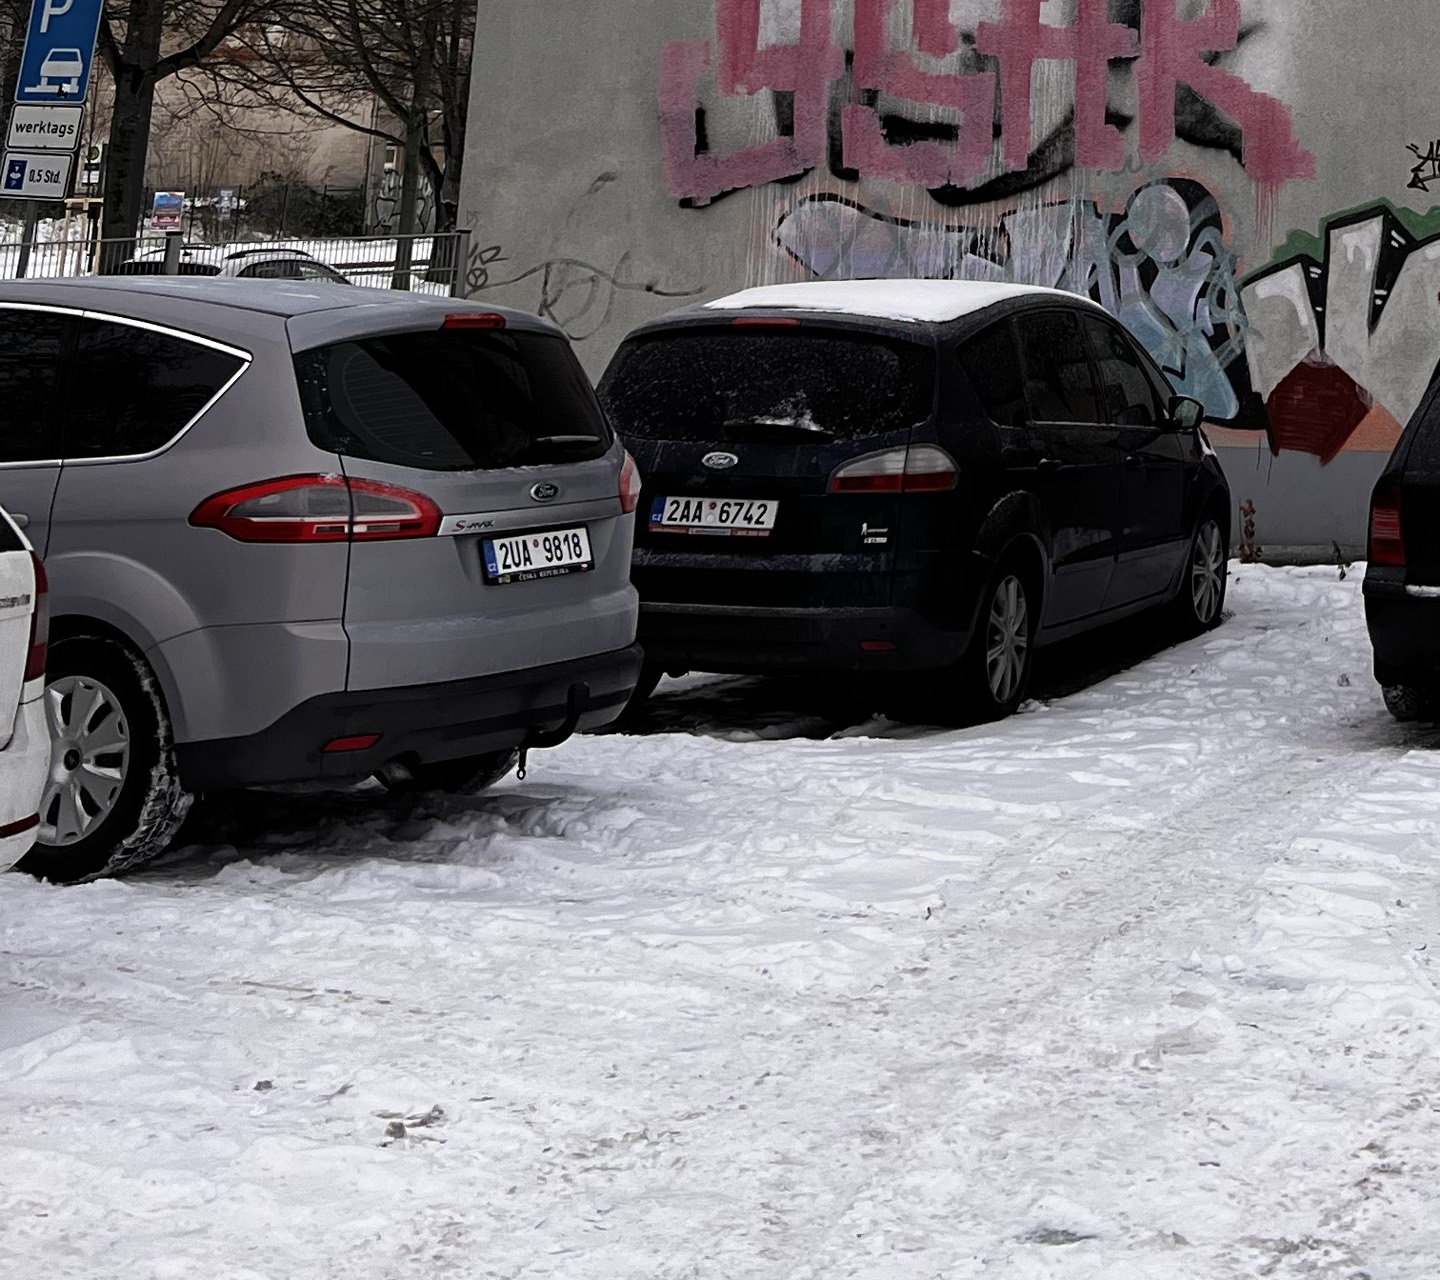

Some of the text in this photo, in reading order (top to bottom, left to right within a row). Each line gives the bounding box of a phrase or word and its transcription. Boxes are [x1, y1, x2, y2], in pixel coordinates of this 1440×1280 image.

[15, 121, 75, 137] werktags
[652, 500, 768, 525] CZ 2AA 6742
[500, 539, 533, 570] 2UA
[543, 533, 583, 562] 9818
